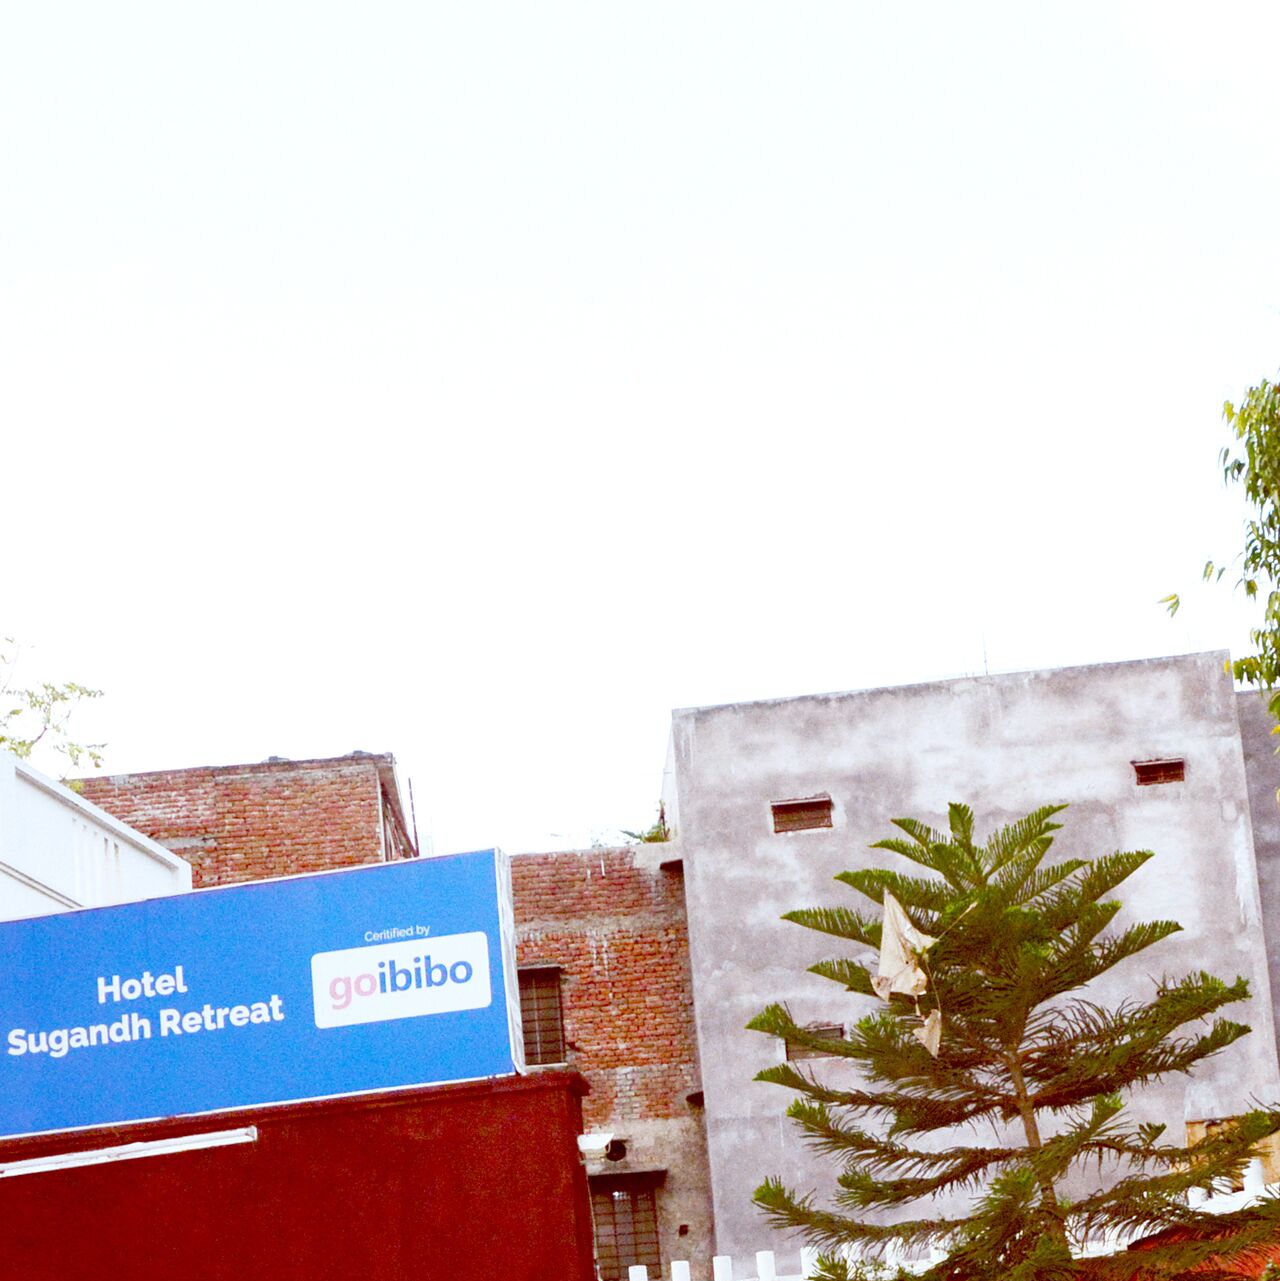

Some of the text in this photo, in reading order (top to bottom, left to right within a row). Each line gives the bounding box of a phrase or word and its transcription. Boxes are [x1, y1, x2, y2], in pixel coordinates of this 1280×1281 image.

[416, 925, 431, 937] by
[97, 965, 188, 1004] Hotel
[329, 955, 473, 1010] goibibo
[7, 994, 285, 1058] Sugandh Retreat
